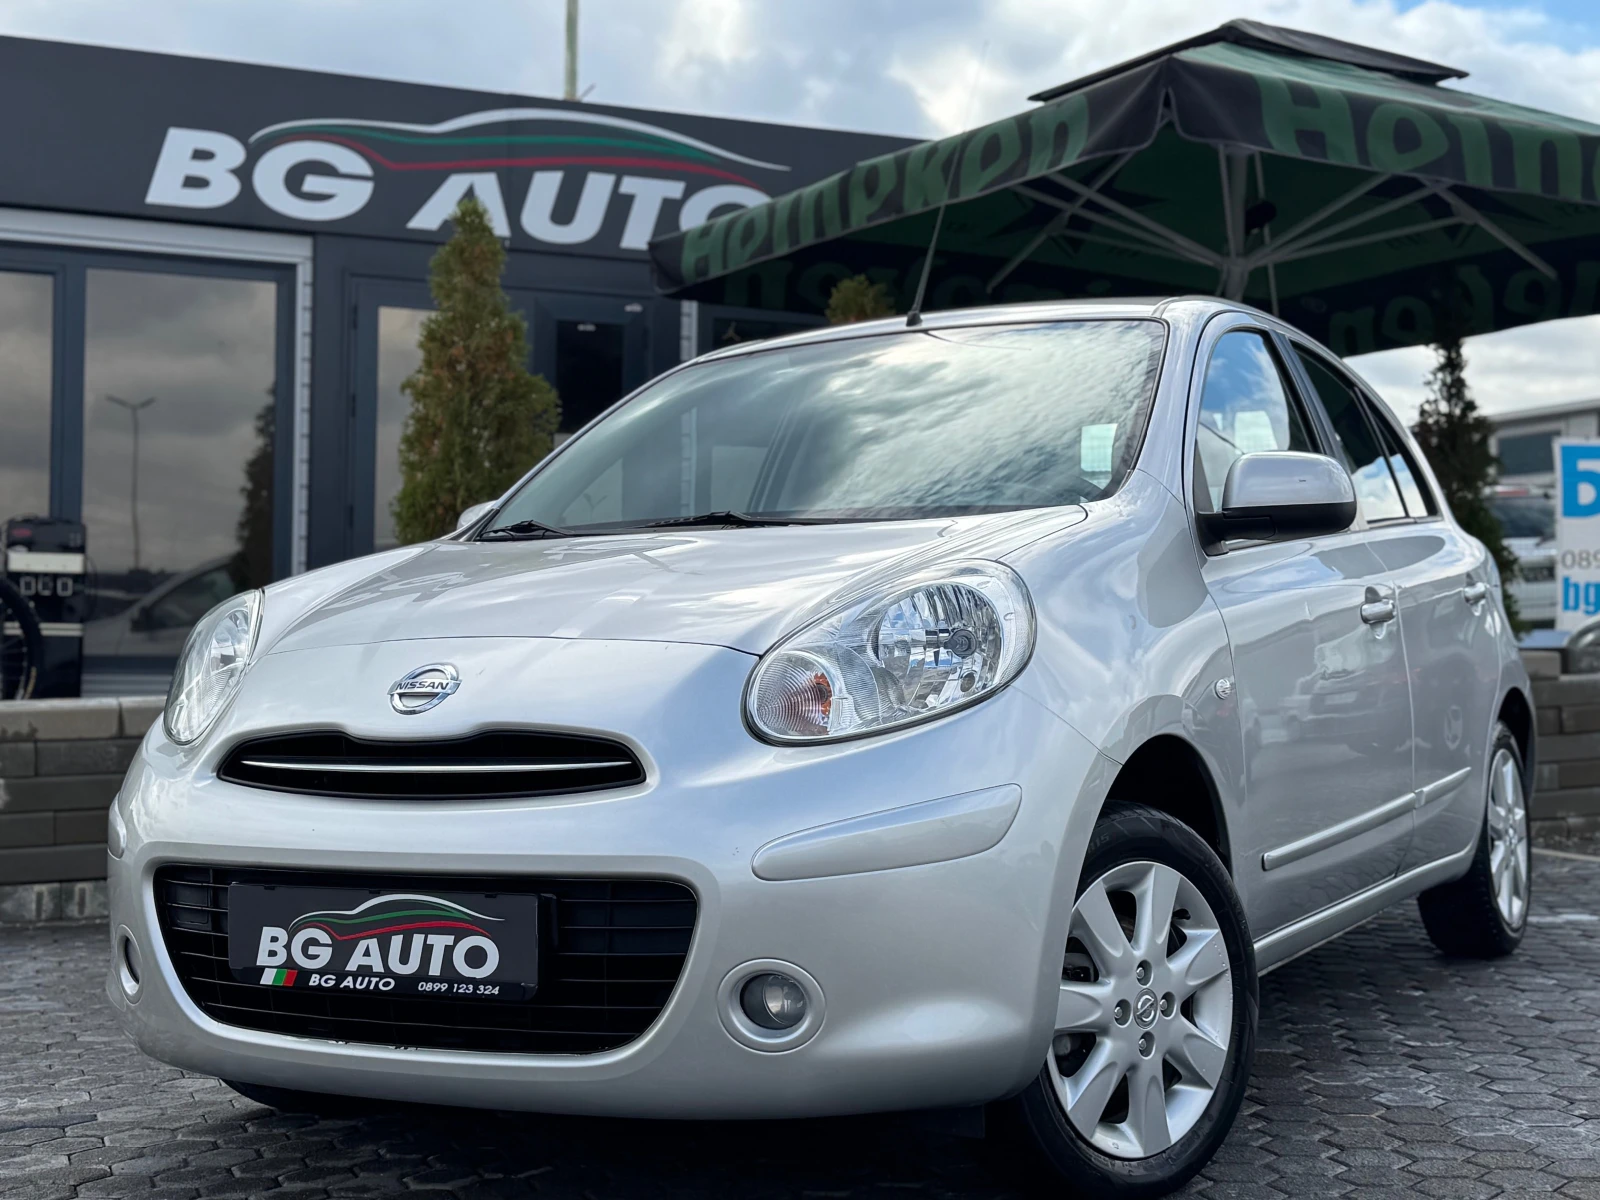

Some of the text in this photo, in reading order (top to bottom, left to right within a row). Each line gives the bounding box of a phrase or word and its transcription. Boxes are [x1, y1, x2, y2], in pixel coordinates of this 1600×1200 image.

[144, 126, 375, 222] BG
[395, 680, 449, 691] NISSAN
[256, 926, 500, 979] BG AUTO
[308, 973, 396, 991] BG AUTO
[418, 981, 500, 995] 0899 123 324
